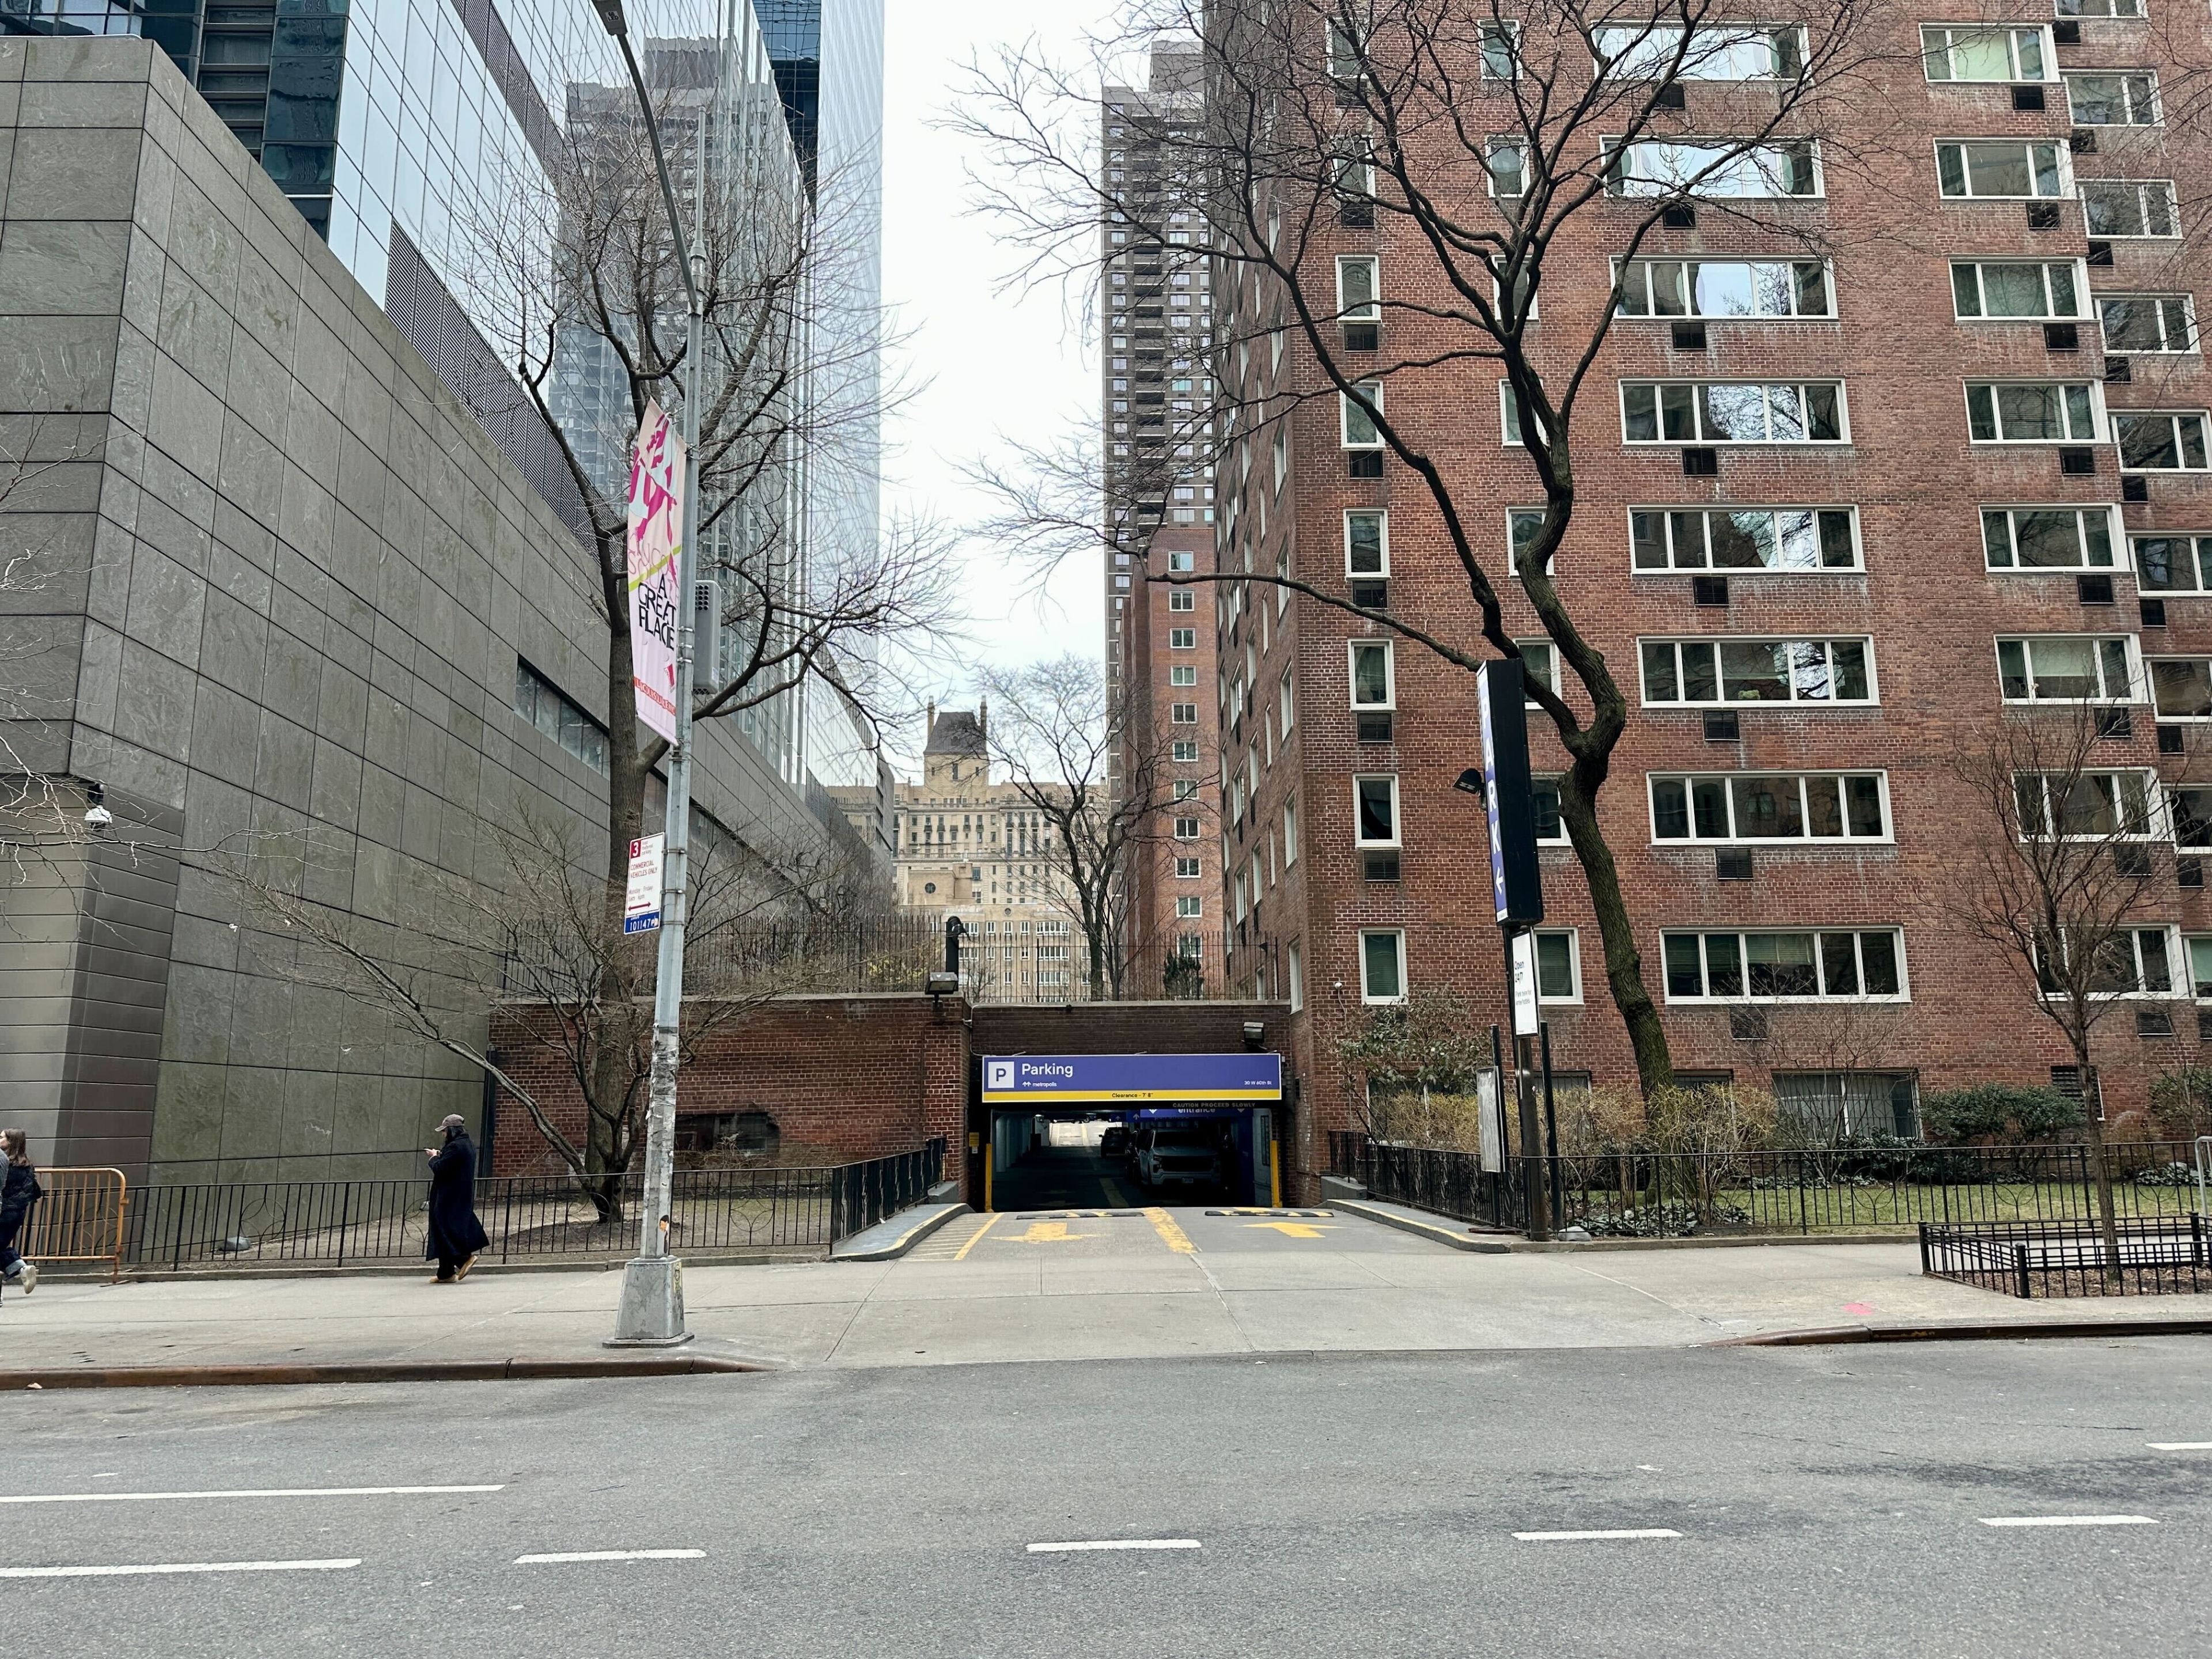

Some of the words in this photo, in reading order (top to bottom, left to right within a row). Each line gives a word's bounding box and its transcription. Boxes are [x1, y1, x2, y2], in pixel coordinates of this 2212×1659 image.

[658, 574, 668, 599] A
[638, 582, 676, 627] GREAT
[639, 604, 675, 651] PLACE
[1481, 696, 1501, 855] PARK
[632, 842, 639, 857] 3
[630, 869, 647, 878] VEHICLES
[648, 866, 658, 875] ONLY
[631, 860, 654, 870] COMMERCIAL
[1514, 961, 1524, 971] Open
[1515, 972, 1523, 984] 24/7
[996, 1068, 1006, 1082] P
[1022, 1063, 1073, 1078] Parking
